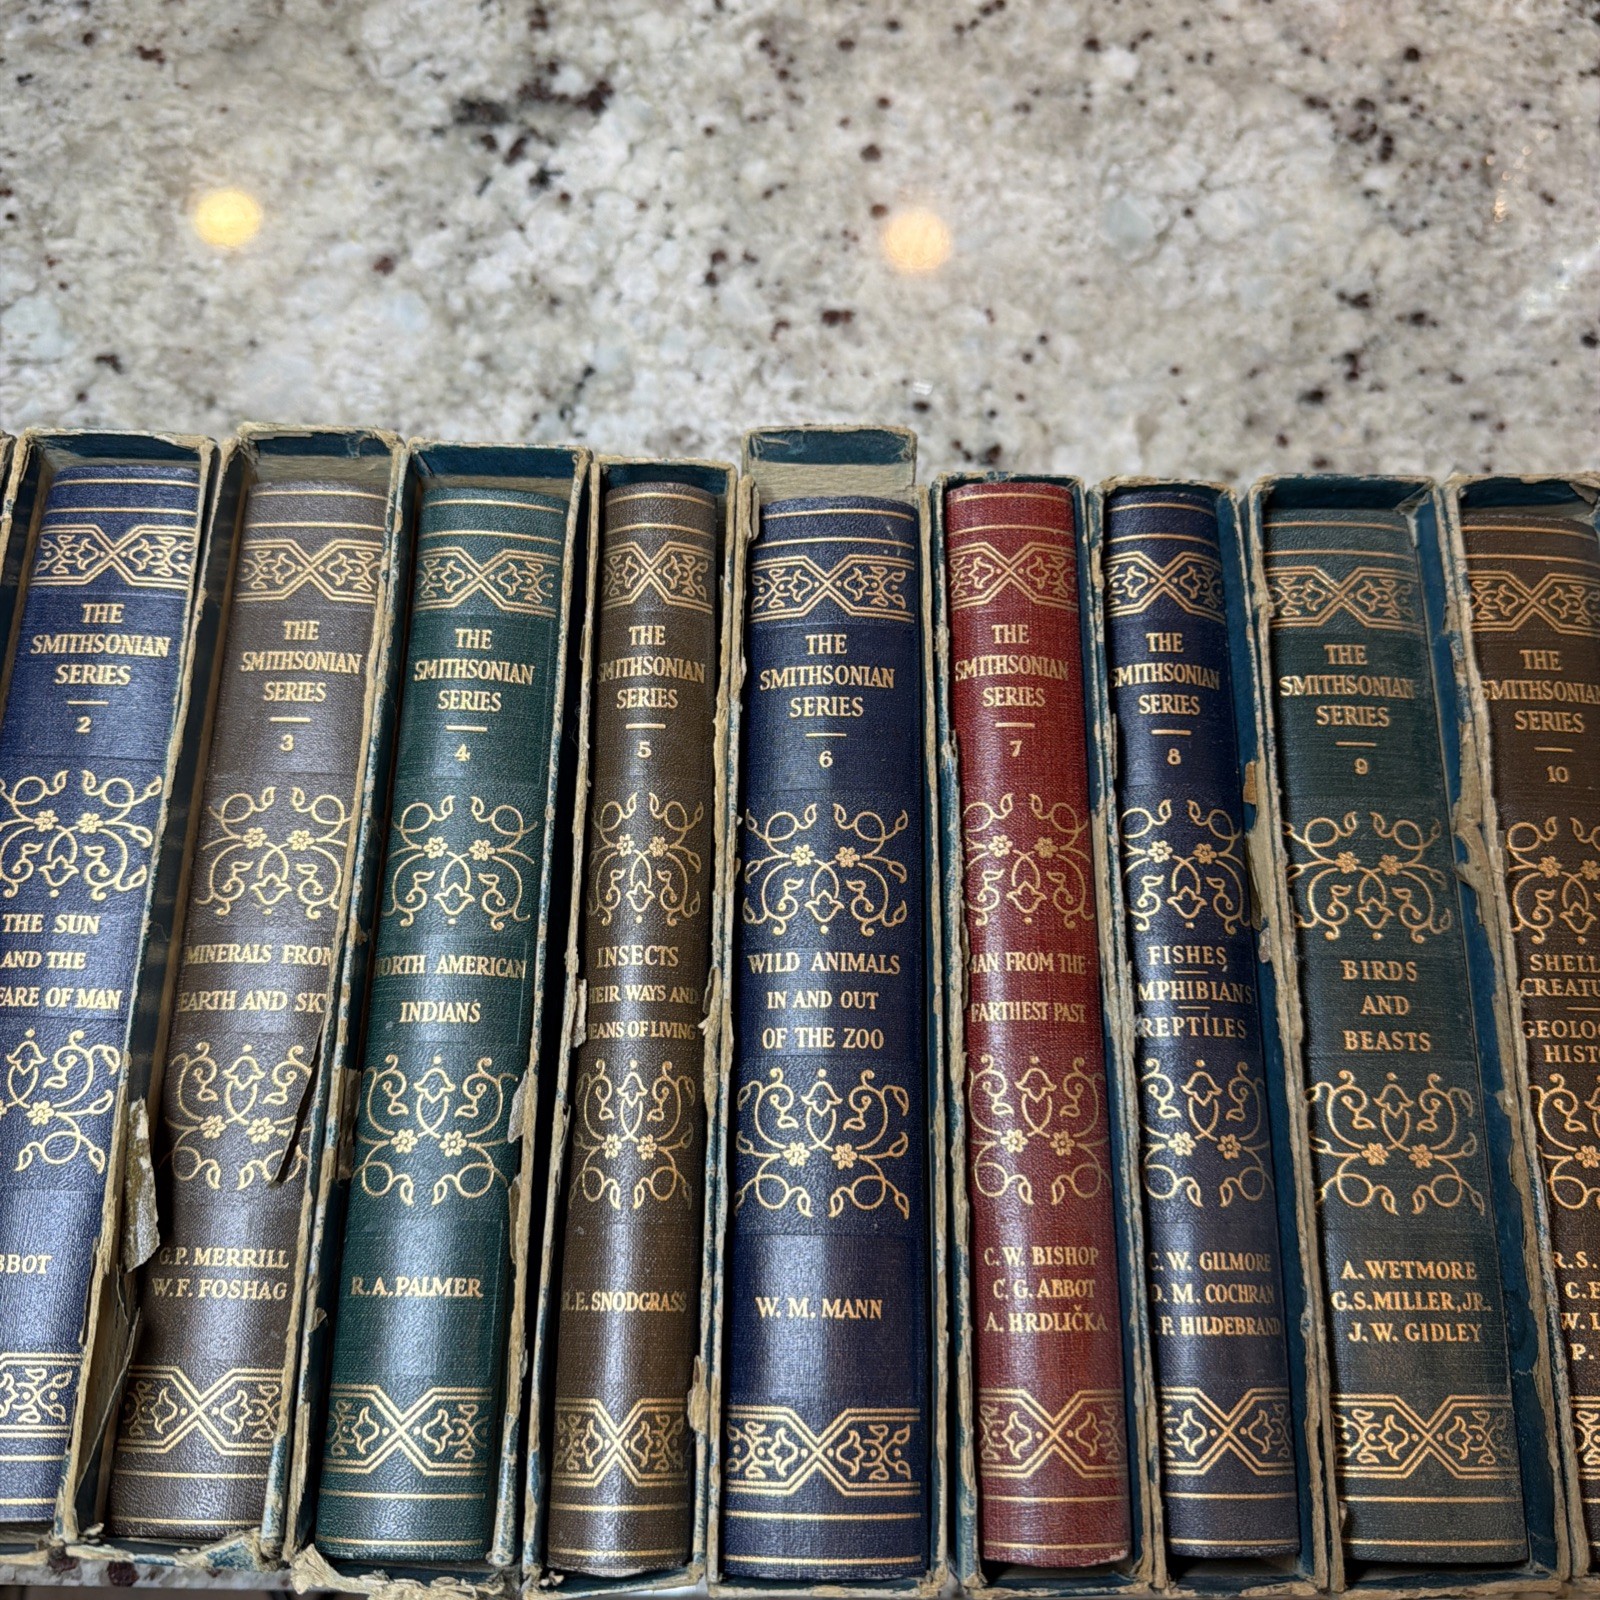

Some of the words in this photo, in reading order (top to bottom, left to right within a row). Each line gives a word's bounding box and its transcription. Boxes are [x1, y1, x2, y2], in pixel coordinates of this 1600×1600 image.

[82, 604, 124, 624] THE
[283, 620, 320, 642] THE
[454, 628, 492, 650] THE
[628, 625, 666, 646] THE
[992, 624, 1030, 644] THE
[1145, 632, 1184, 652] THE
[30, 634, 171, 658] SMITHSONIAN
[804, 634, 848, 655] THE
[1324, 644, 1368, 666] THE
[240, 652, 362, 674] SMITHSONIAN
[954, 654, 1068, 682] SMITHSONIAN
[1518, 648, 1564, 672] THE
[54, 664, 132, 686] SERIES
[414, 660, 536, 686] SMITHSONIAN
[760, 664, 895, 691] SMITHSONIAN
[1110, 662, 1220, 690] SMITHSONIAN
[263, 680, 326, 702] SERIES
[616, 686, 678, 710] SERIES
[982, 686, 1046, 708] SERIES
[1280, 674, 1416, 700] SMITHSONIAN
[438, 690, 502, 712] SERIES
[790, 696, 864, 718] SERIES
[1138, 694, 1200, 716] SERIES
[76, 716, 92, 734] 2
[1316, 705, 1390, 728] SERIES
[1514, 710, 1586, 734] SERIES
[280, 734, 294, 752] 3
[454, 744, 470, 761] 4
[637, 742, 651, 758] 5
[1010, 740, 1022, 758] 7
[819, 750, 833, 768] 6
[1166, 748, 1182, 766] 8
[1354, 758, 1368, 776] 9
[1546, 764, 1570, 784] 10
[2, 914, 44, 933] THE
[52, 914, 102, 934] SUN
[0, 950, 42, 968] AND
[46, 950, 86, 970] THE
[184, 943, 272, 966] MINERALS
[596, 944, 680, 968] INSECTS
[748, 952, 800, 974] WILD
[810, 952, 900, 976] ANIMALS
[1004, 951, 1054, 972] FROM
[1058, 952, 1086, 974] THE
[1148, 945, 1228, 966] FISHES
[434, 954, 528, 980] AMERICAN
[1342, 960, 1418, 982] BIRDS
[44, 986, 74, 1008] OF
[74, 988, 122, 1010] MAN
[176, 990, 238, 1012] EARTH
[238, 990, 288, 1012] AND
[624, 984, 666, 1002] WAYS
[668, 986, 698, 1004] AND
[766, 990, 787, 1010] IN
[792, 990, 833, 1010] AND
[840, 990, 880, 1010] OUT
[400, 1000, 482, 1024] INDIANS
[970, 1001, 1048, 1022] FARTHEST
[1052, 1002, 1086, 1023] PAST
[1360, 996, 1410, 1016] AND
[626, 1020, 650, 1038] OF
[650, 1020, 696, 1040] LIVING
[762, 1028, 787, 1050] OF
[794, 1027, 836, 1048] THE
[842, 1028, 884, 1050] ZOO
[1140, 1016, 1248, 1040] REPTILES
[1343, 1030, 1432, 1052] BEASTS
[192, 1248, 290, 1268] MERRILL
[1032, 1244, 1098, 1266] BISHOP
[1200, 1251, 1272, 1272] GILMORE
[198, 1278, 288, 1300] FOSHAG
[1036, 1278, 1096, 1298] ABBOT
[1204, 1284, 1274, 1304] COCHRAN
[592, 1290, 686, 1312] SNODGRASS
[754, 1296, 782, 1318] W.
[788, 1296, 816, 1318] M.
[820, 1298, 882, 1320] MANN
[984, 1312, 1004, 1332] A.
[1008, 1304, 1108, 1334] HRDLIČKA
[1404, 1322, 1482, 1344] GIDLEY
